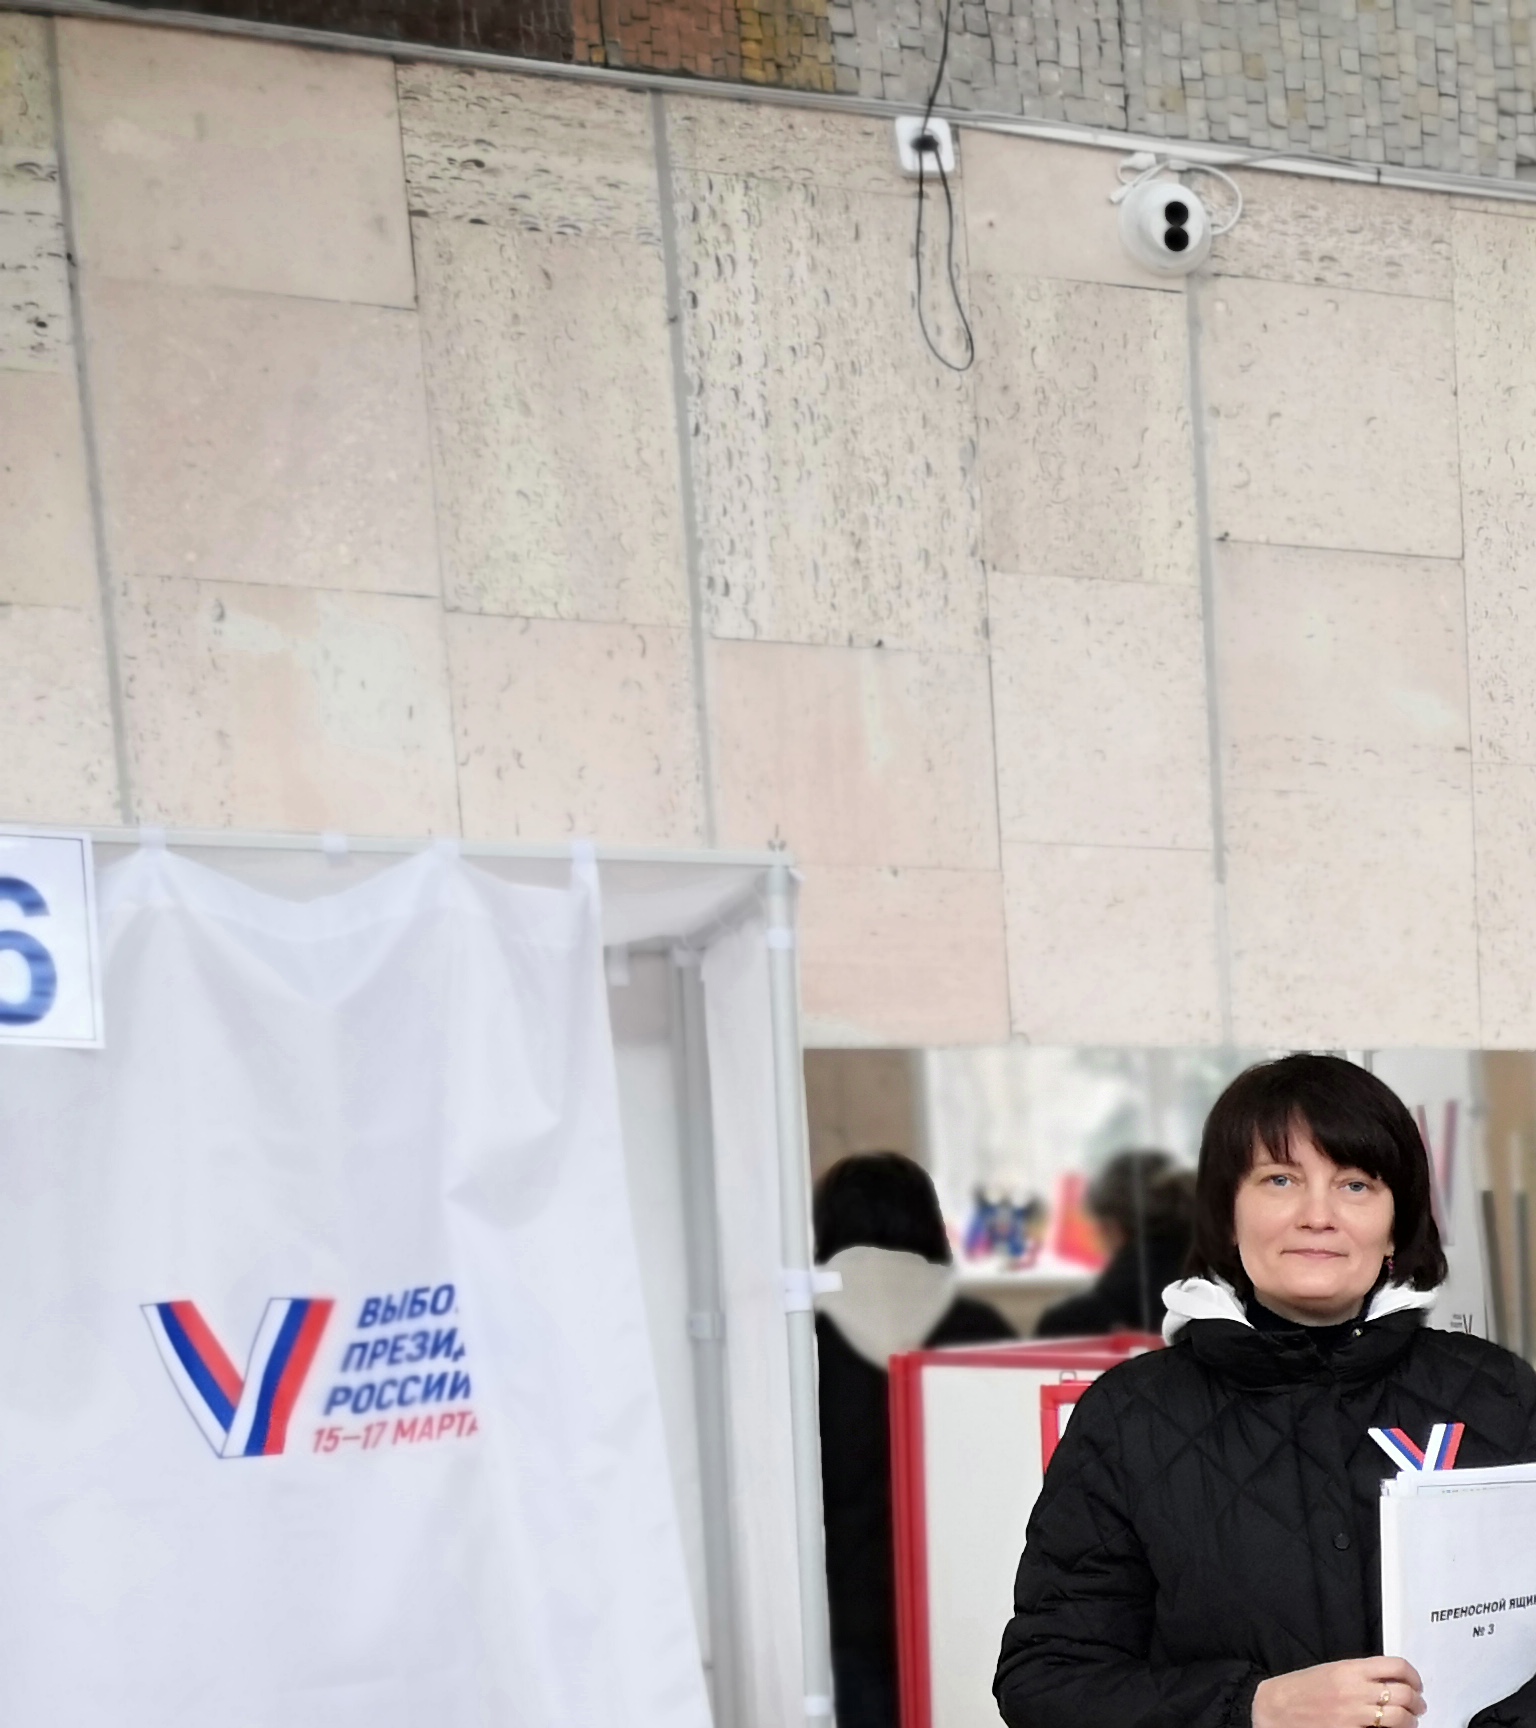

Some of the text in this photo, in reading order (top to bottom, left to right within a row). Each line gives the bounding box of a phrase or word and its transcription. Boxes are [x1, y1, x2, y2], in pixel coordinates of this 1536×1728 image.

[357, 1283, 459, 1329] ВЫБО
[323, 1370, 471, 1416] РОССИИ
[1431, 1598, 1507, 1622] ПЕРЕНОСНОЙ
[1488, 1623, 1496, 1636] 3
